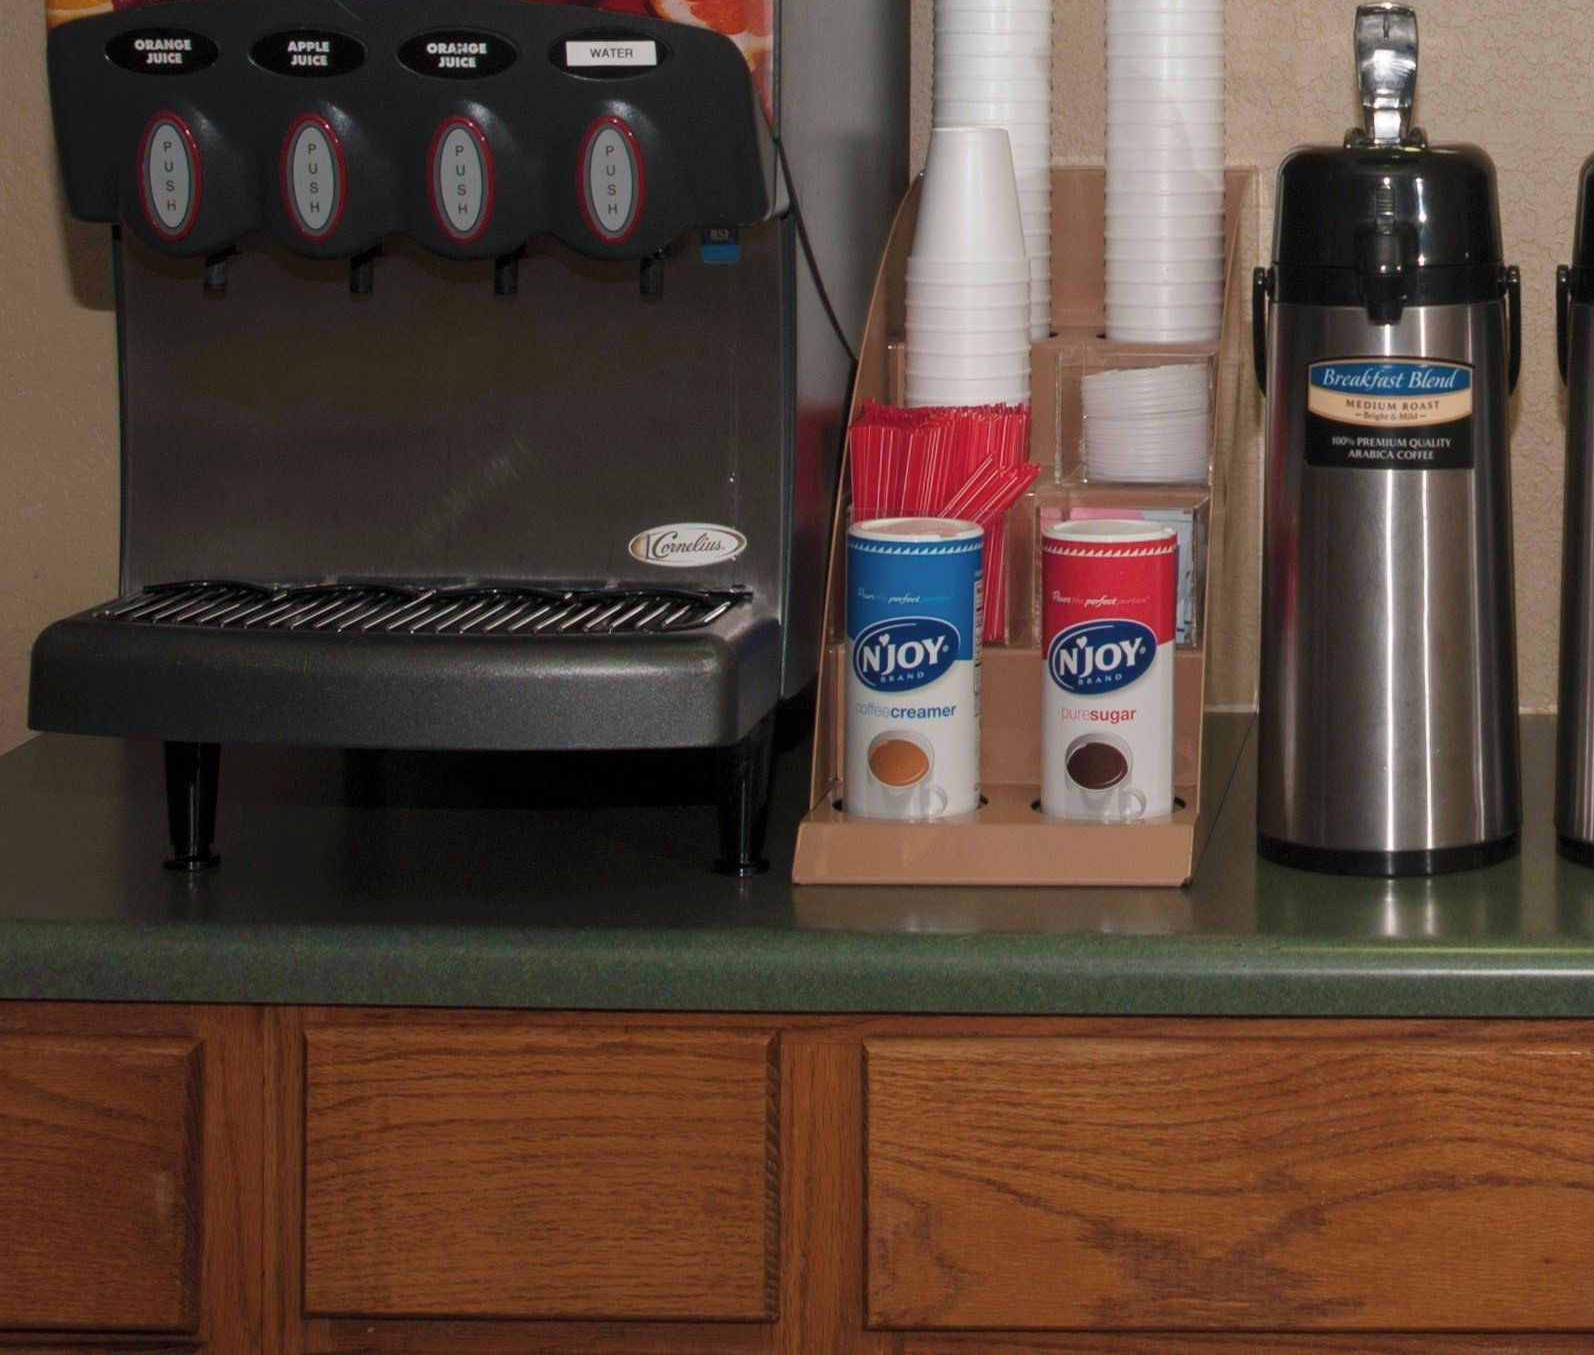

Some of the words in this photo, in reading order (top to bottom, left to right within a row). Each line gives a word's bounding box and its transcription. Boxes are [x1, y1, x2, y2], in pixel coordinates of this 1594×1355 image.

[134, 38, 192, 52] ORANGE
[287, 41, 330, 53] APPLE
[426, 42, 487, 55] ORANGE
[146, 52, 182, 65] JUICE
[589, 47, 634, 59] WATER
[291, 55, 328, 66] JUICE
[438, 56, 476, 68] JUICE
[163, 141, 177, 212] PUSH
[307, 143, 320, 213] PUSH
[455, 145, 468, 215] PUSH
[605, 145, 618, 215] PUSH
[1322, 367, 1405, 391] Breakfast
[1408, 367, 1461, 389] Blend
[1346, 399, 1397, 411] MEDIUM
[1402, 400, 1441, 411] ROAST
[1357, 437, 1407, 447] PREMIUM
[1409, 438, 1451, 449] QUALITY
[1348, 449, 1394, 459] ARABICA
[1397, 450, 1434, 460] COFFEE
[652, 530, 722, 559] Cornelius
[880, 671, 925, 683] BRAND
[1078, 673, 1122, 685] BRAND
